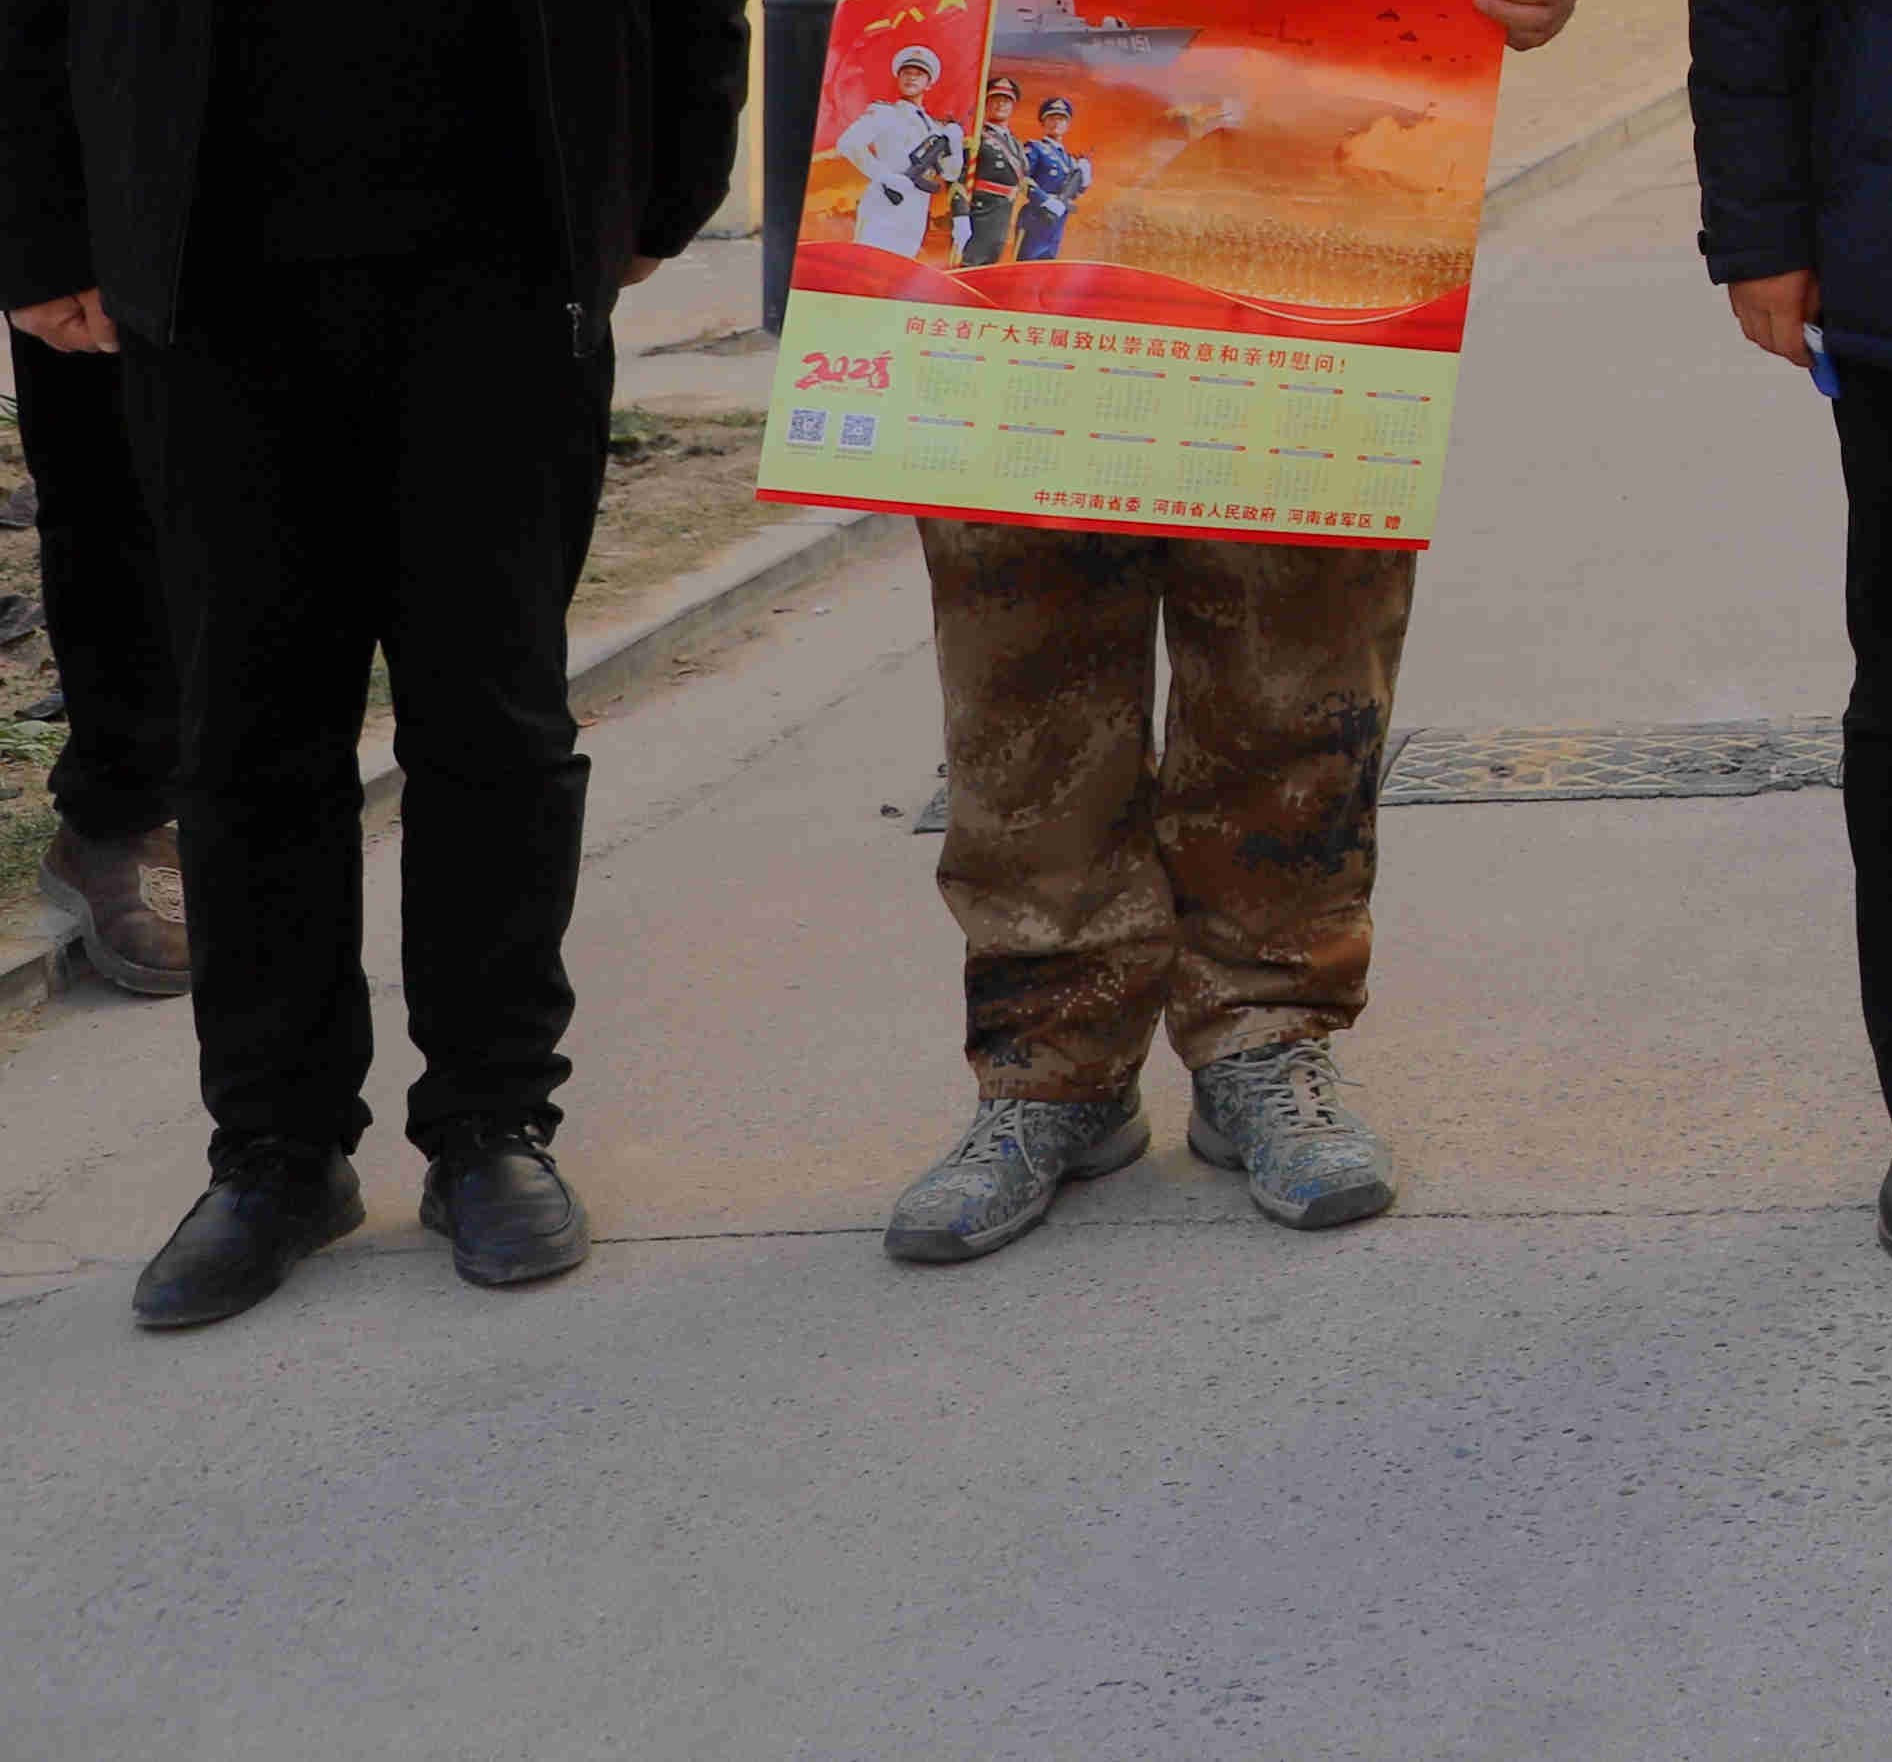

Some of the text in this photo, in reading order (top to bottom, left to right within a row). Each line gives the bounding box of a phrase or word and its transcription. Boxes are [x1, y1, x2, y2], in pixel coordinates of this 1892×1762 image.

[1034, 489, 1141, 514] 中共河南省委
[1153, 498, 1278, 524] 河南省人民政府
[1288, 508, 1373, 529] 河南省军区
